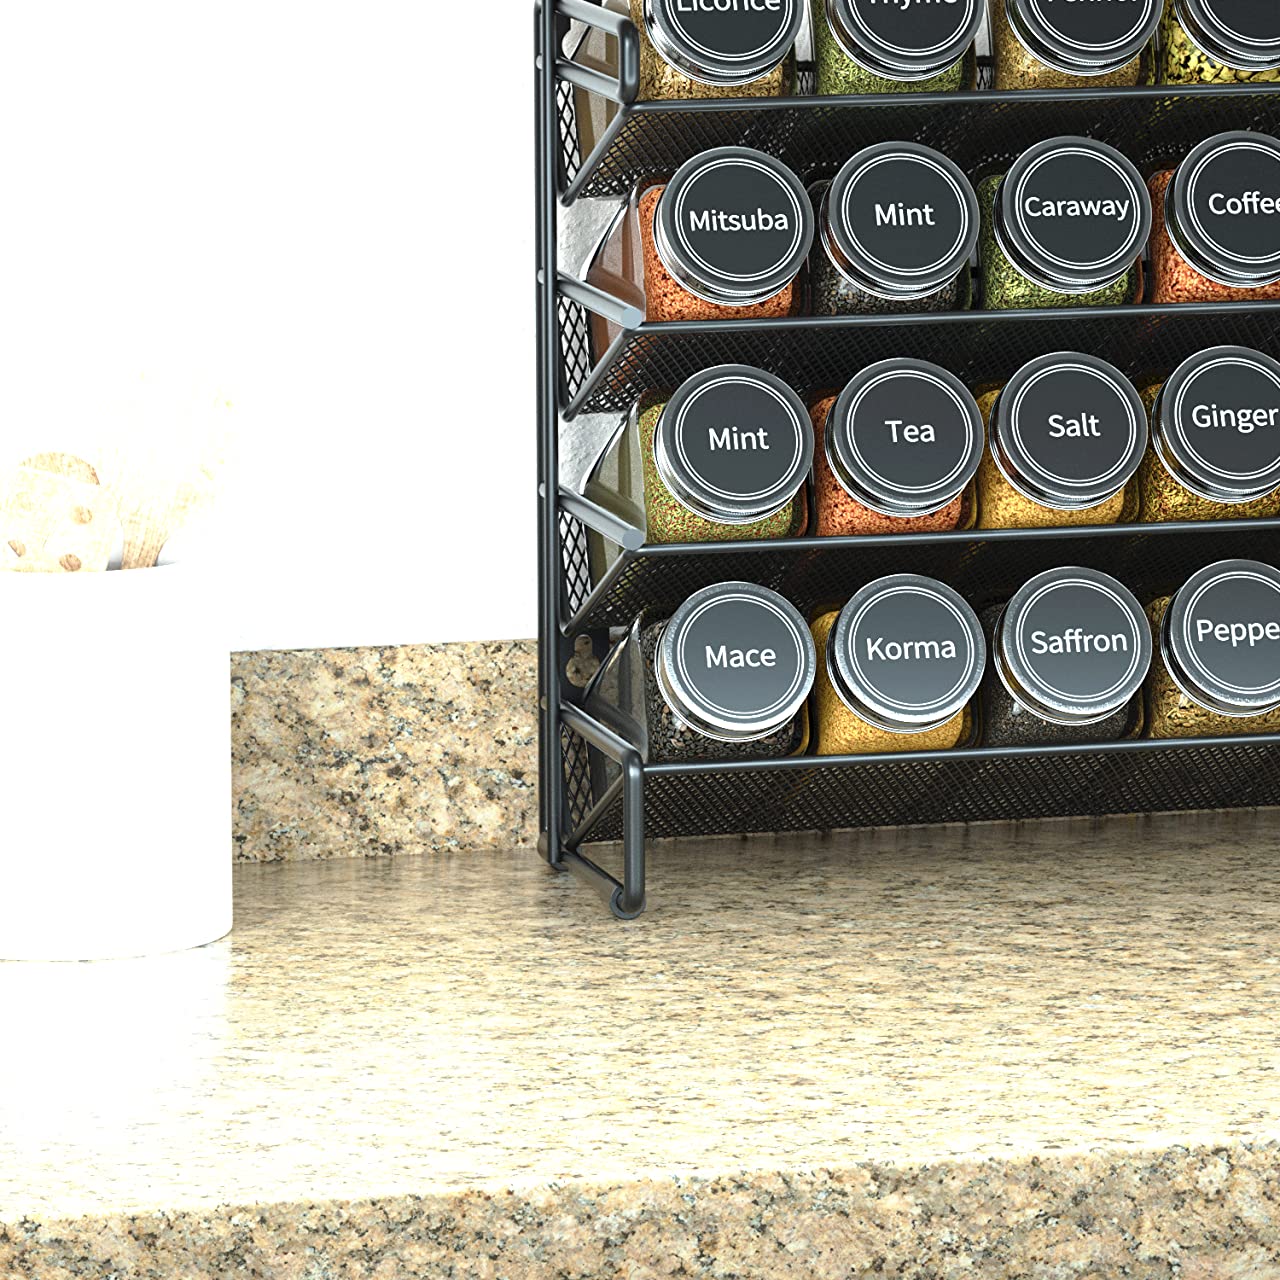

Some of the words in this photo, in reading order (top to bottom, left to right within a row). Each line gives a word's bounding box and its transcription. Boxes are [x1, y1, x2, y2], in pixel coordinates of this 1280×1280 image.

[689, 207, 789, 232] Mitsuba
[874, 202, 936, 227] Mint
[1024, 196, 1130, 222] Caraway
[884, 419, 936, 443] Tea
[1048, 412, 1102, 438] Salt
[1191, 403, 1280, 434] Ginger
[708, 425, 770, 451] Mint
[866, 637, 957, 661] Korma
[1030, 627, 1128, 655] Saffron
[705, 645, 777, 669] Mace
